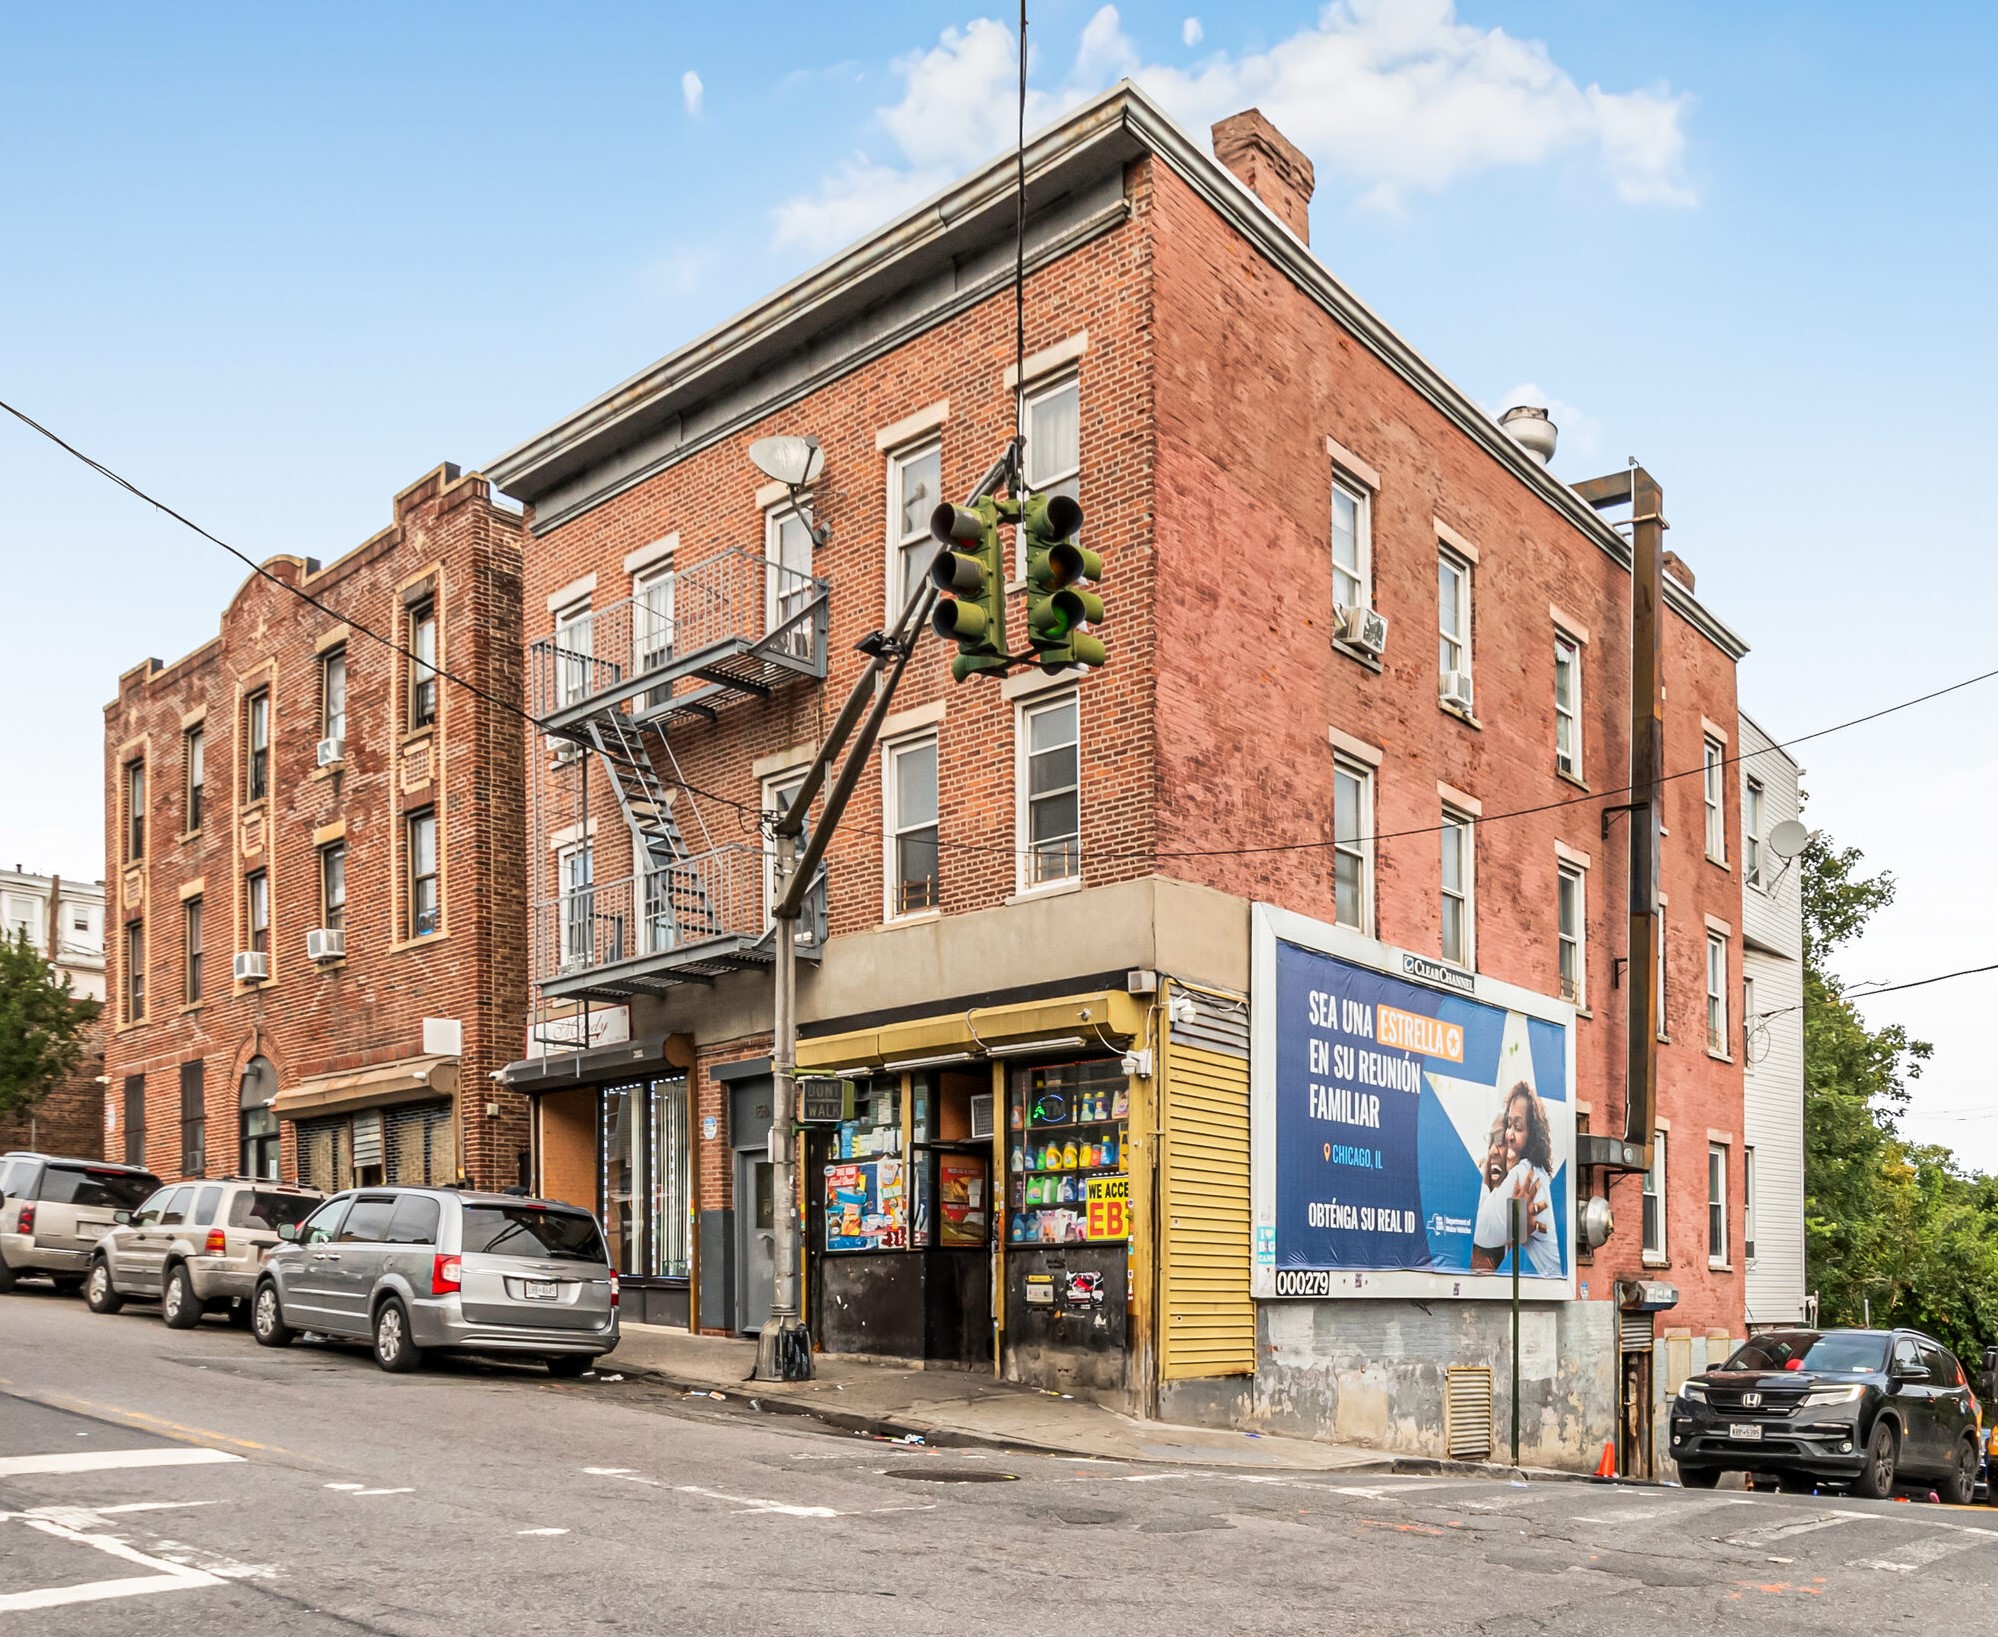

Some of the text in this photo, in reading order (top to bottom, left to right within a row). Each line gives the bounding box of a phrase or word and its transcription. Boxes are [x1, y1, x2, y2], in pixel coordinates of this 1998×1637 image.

[1309, 990, 1444, 1055] SEA UNA ESTRELLA
[1309, 1039, 1421, 1094] EN SU REUNIÓN
[808, 1102, 839, 1117] WALK
[1309, 1083, 1380, 1129] FAMILIAR
[1332, 1144, 1383, 1170] CHICAGO, IL
[1089, 1183, 1102, 1199] WE
[1090, 1201, 1129, 1236] EB
[1308, 1197, 1359, 1231] OBTÉNGA
[1361, 1208, 1375, 1232] SU
[1377, 1208, 1403, 1234] REAL
[1404, 1211, 1416, 1234] ID
[1276, 1271, 1330, 1295] 000279
